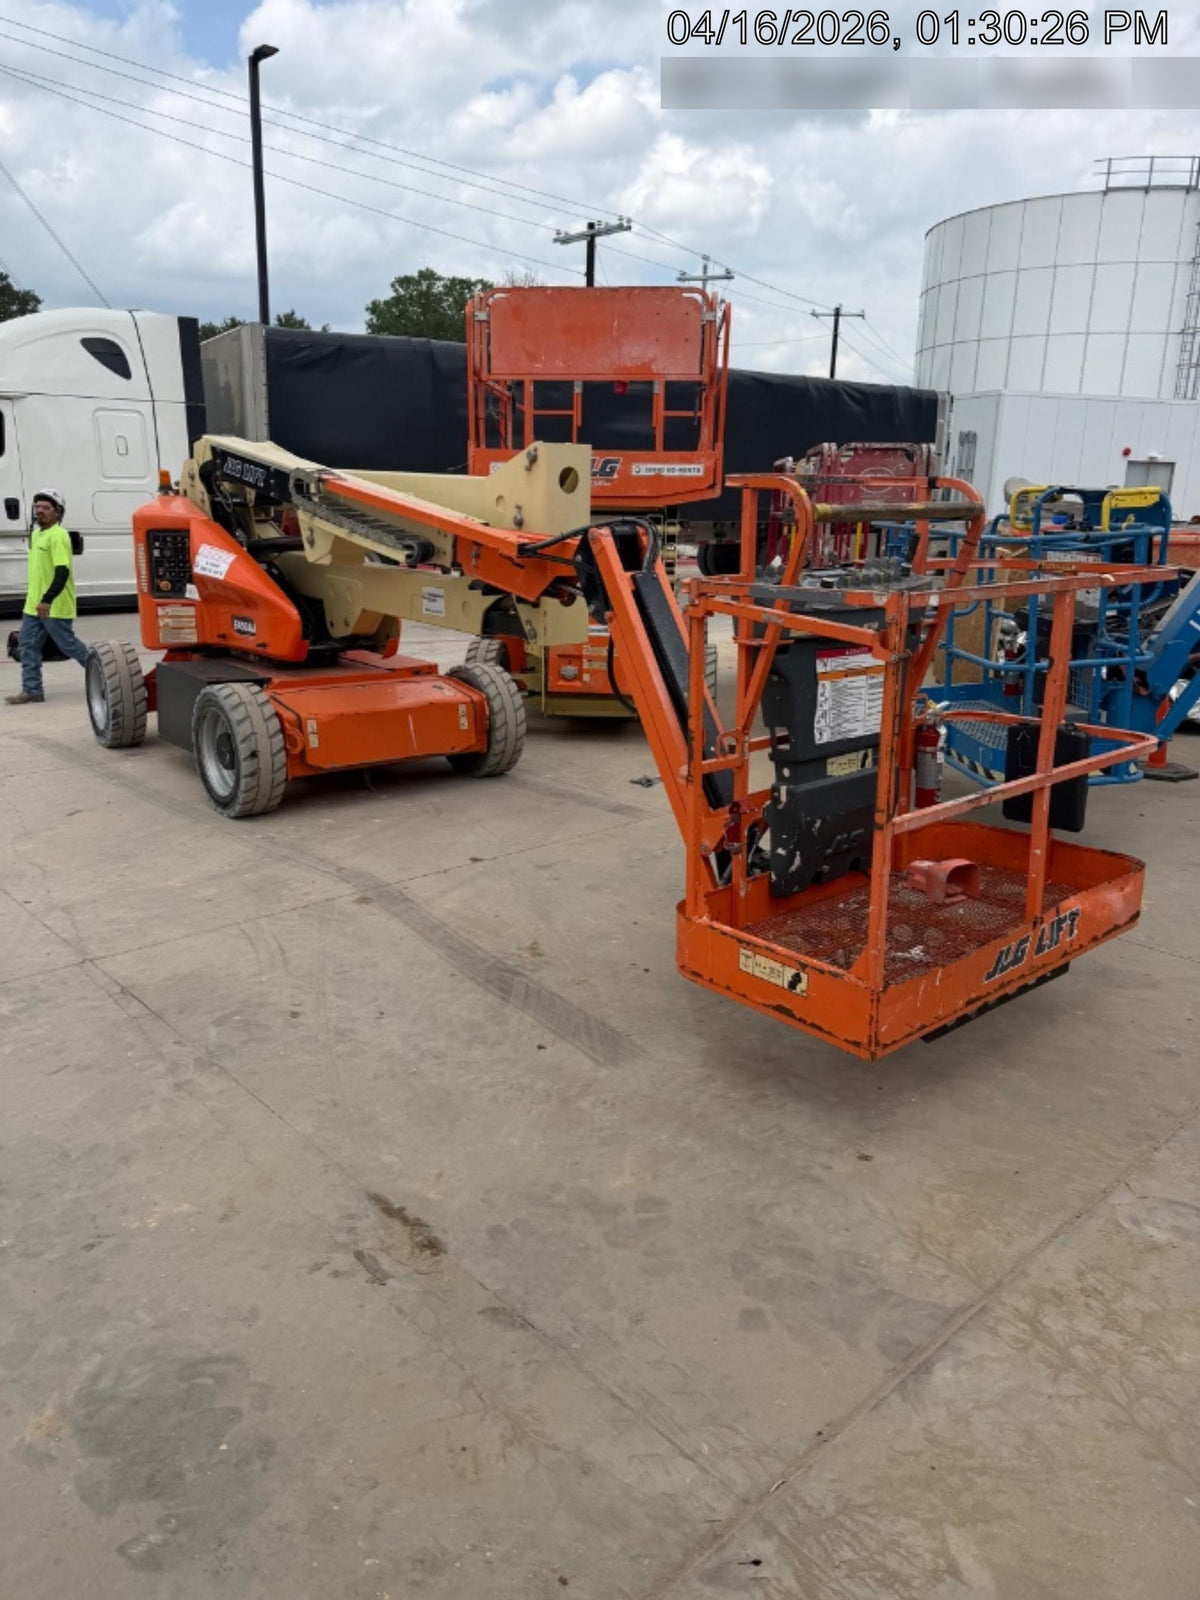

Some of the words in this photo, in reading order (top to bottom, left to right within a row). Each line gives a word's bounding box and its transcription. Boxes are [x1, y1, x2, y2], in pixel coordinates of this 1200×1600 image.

[591, 456, 622, 479] LG
[983, 934, 1031, 983] JLG
[1034, 906, 1081, 957] LIFT
